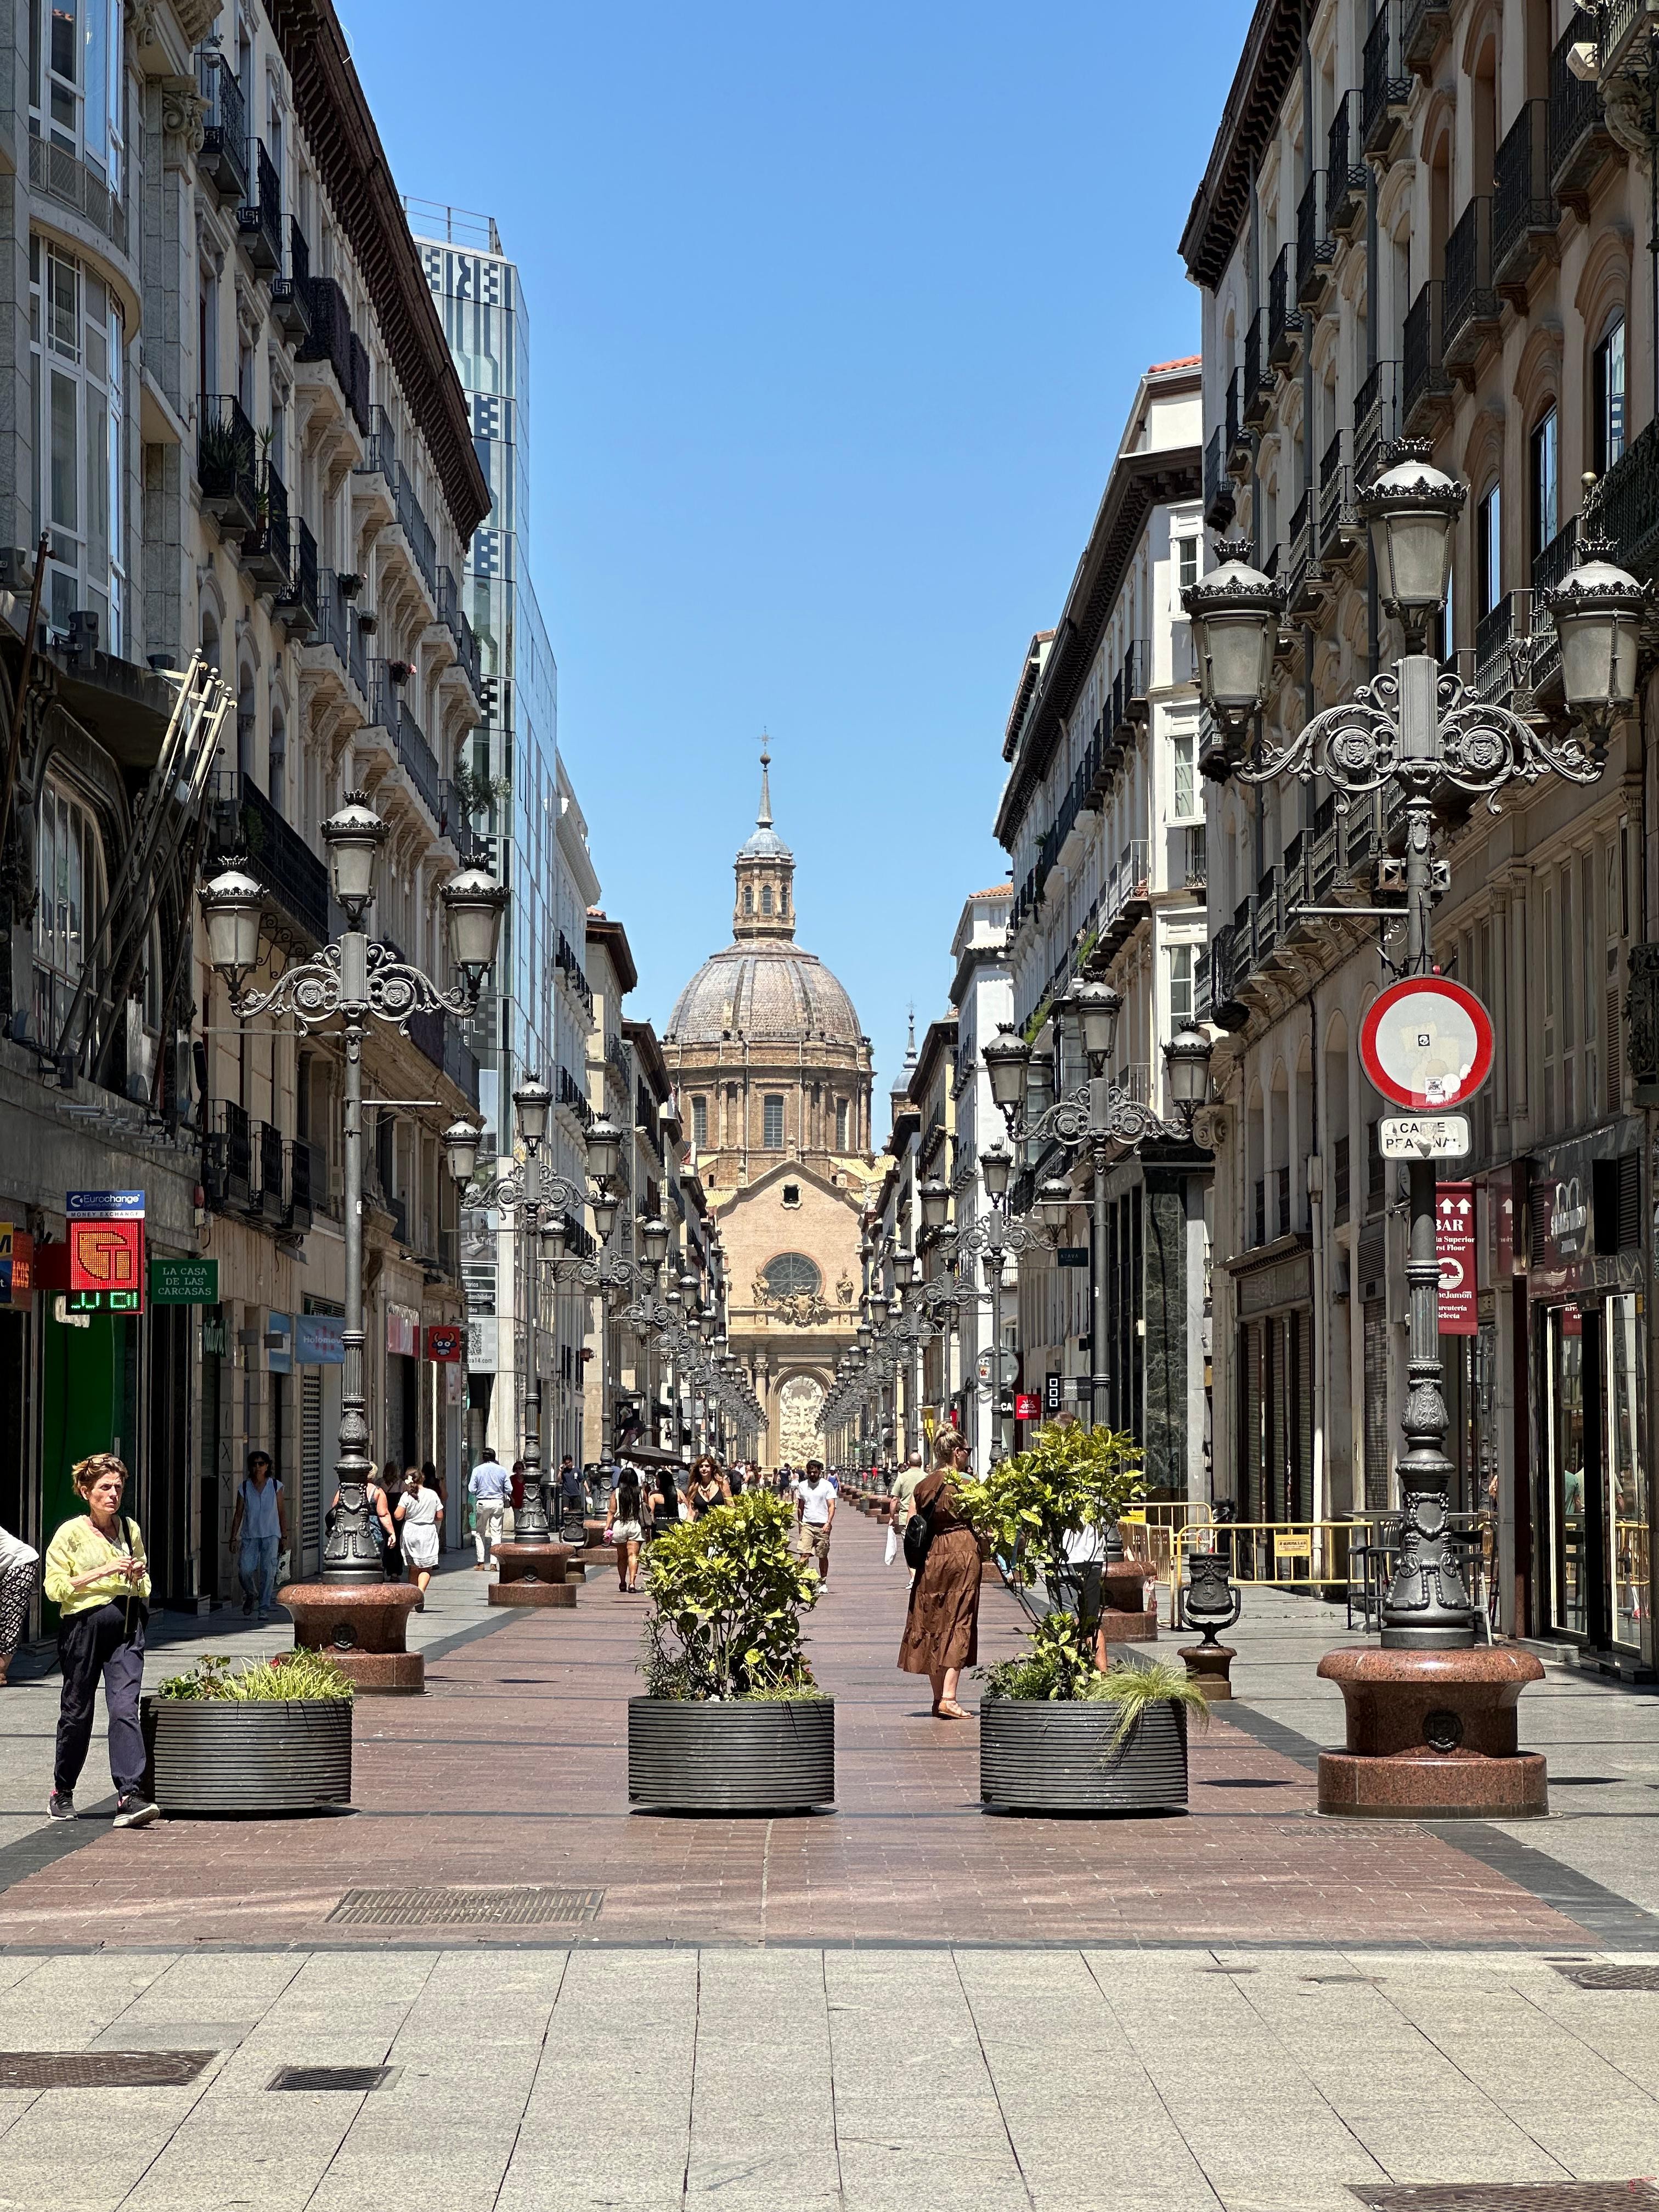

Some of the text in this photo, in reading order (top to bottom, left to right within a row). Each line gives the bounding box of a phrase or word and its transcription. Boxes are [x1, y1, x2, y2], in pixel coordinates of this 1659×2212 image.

[1400, 1122, 1446, 1133] CAE
[83, 1194, 139, 1204] Eurochange
[1436, 1219, 1464, 1232] BAR
[1443, 1235, 1475, 1244] Superior
[180, 1267, 207, 1276] CASA
[166, 1277, 204, 1285] DE LAS
[158, 1287, 212, 1295] CARCASAS
